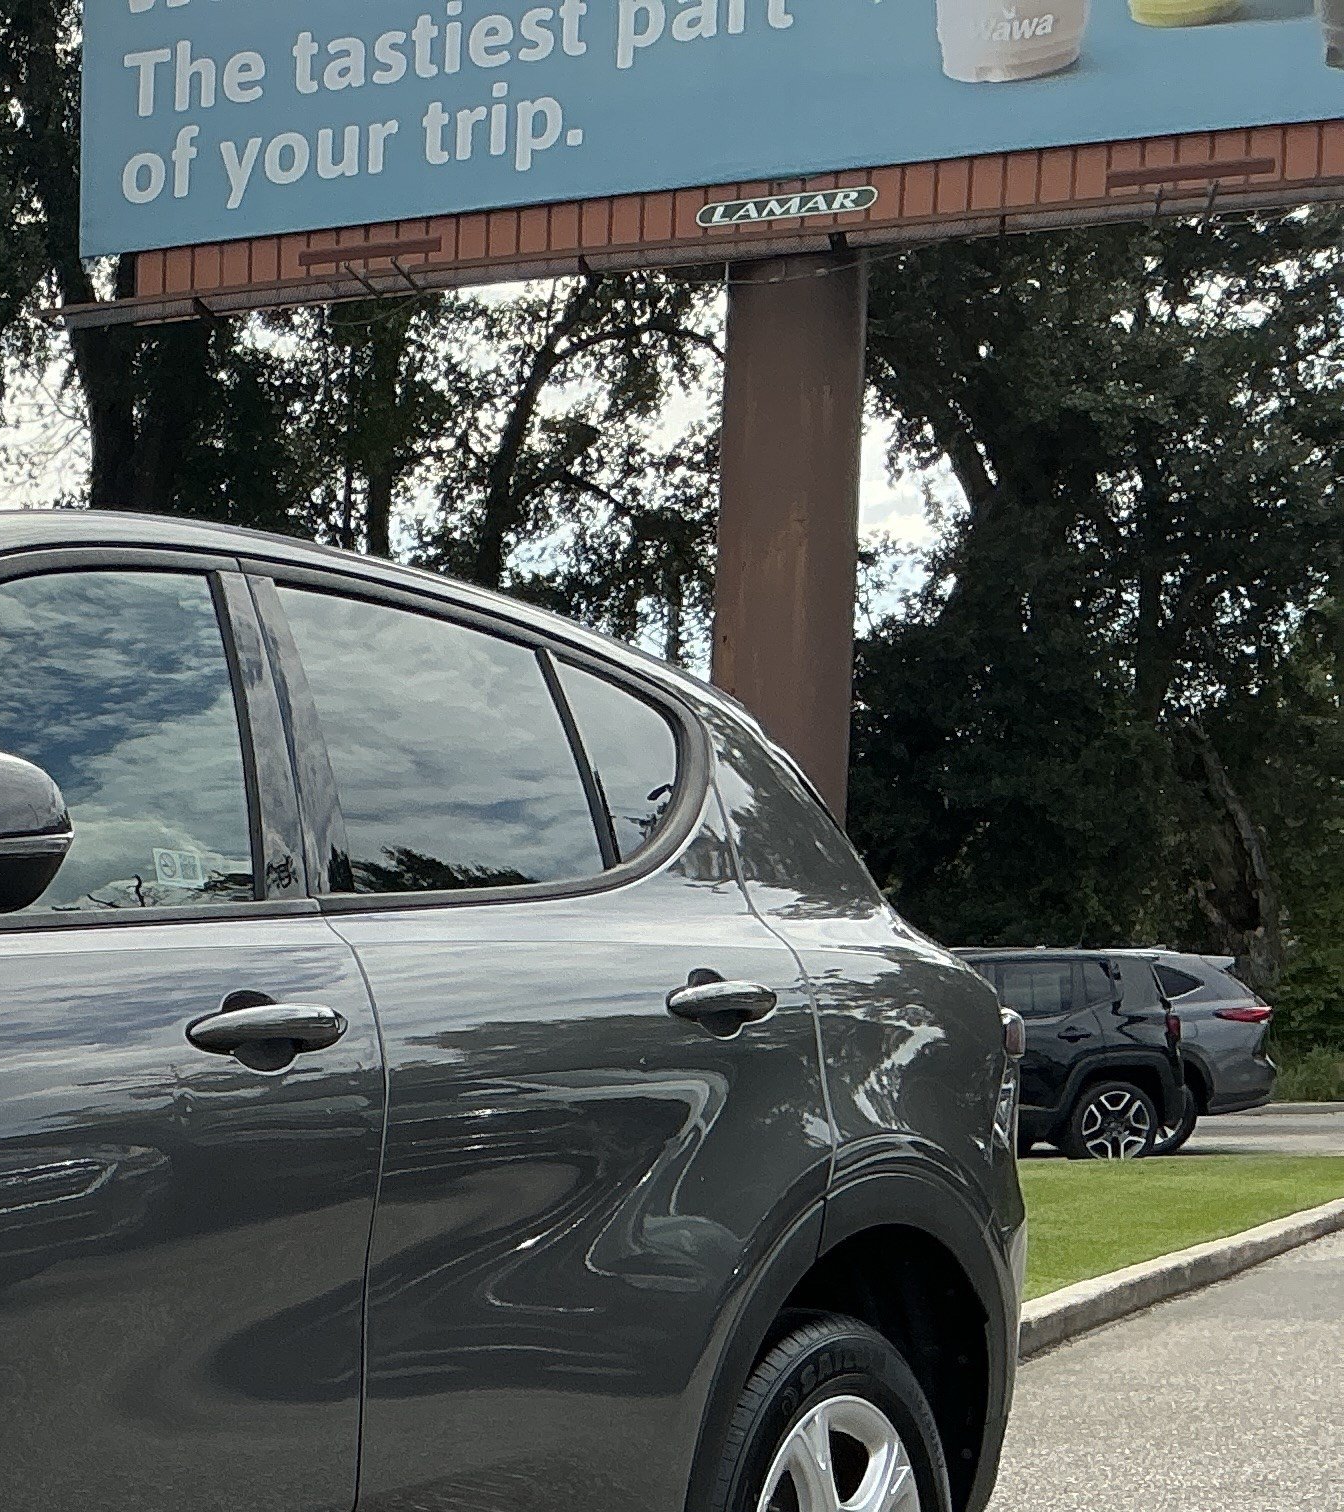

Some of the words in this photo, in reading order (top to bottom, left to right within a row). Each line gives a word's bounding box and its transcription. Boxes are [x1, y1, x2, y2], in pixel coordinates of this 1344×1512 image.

[123, 40, 266, 117] The
[292, 0, 588, 94] tastiest
[121, 125, 200, 205] of
[219, 119, 399, 210] your
[422, 82, 584, 172] trip.
[710, 188, 861, 226] LAMAR
